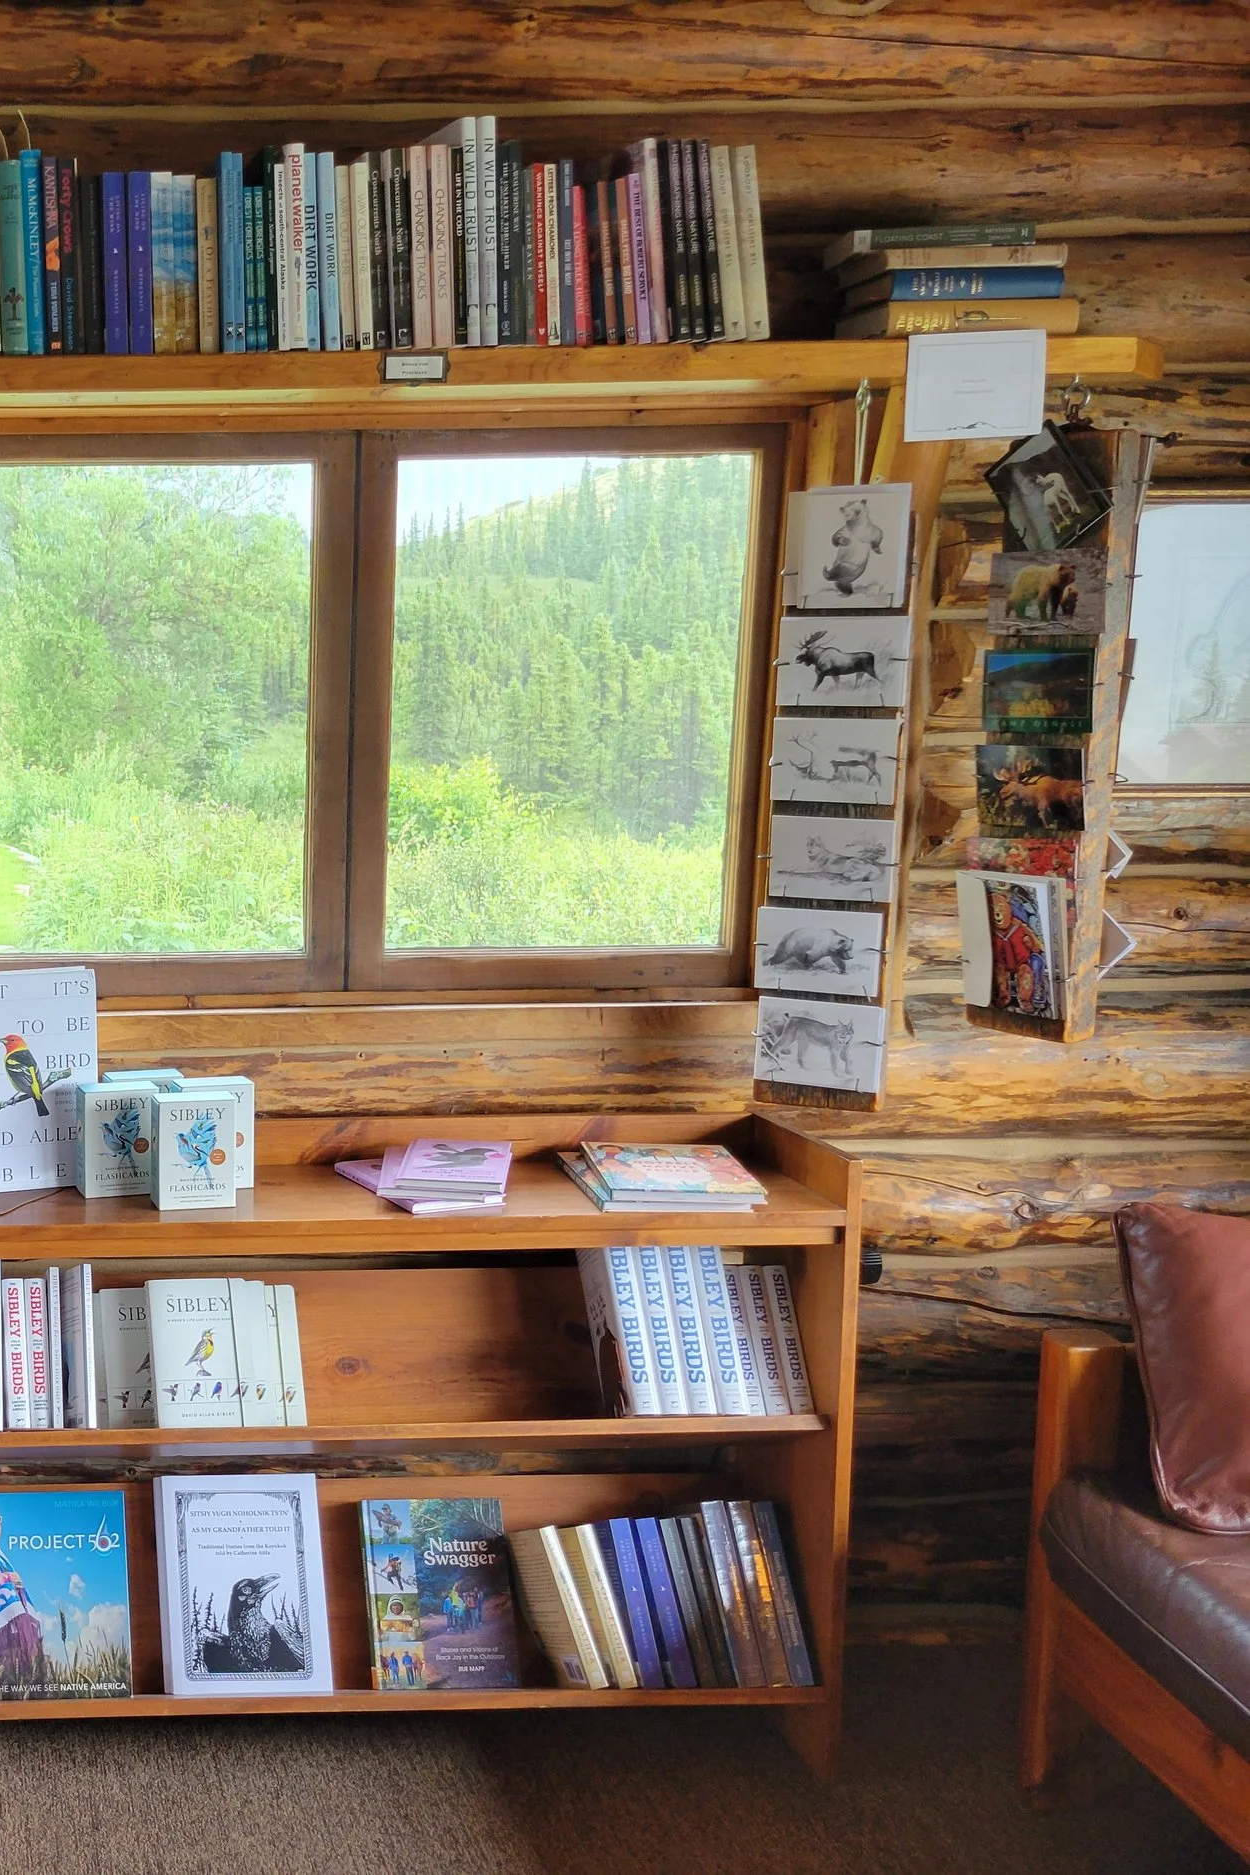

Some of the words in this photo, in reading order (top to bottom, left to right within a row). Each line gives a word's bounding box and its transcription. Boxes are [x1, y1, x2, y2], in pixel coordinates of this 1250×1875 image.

[464, 138, 475, 153] IN
[484, 137, 494, 152] IN
[44, 166, 59, 229] KANTISHNA
[60, 168, 72, 207] Forty
[393, 167, 404, 227] Crosscurrents
[464, 160, 476, 200] WILD
[484, 160, 495, 199] WILD
[536, 172, 544, 220] WARNINGS
[672, 143, 682, 220] PHOTOGRAPHING
[685, 144, 696, 220] PHOTOGRAPHING
[701, 143, 713, 218] PHOTOGRAPHING
[244, 192, 252, 219] FOREST
[254, 191, 262, 218] FOREST
[371, 170, 380, 229] Crosscurrents
[435, 188, 447, 250] CHANGING
[62, 211, 73, 254] Crows
[255, 221, 264, 259] FORENSICS
[278, 210, 286, 260] south-central
[305, 205, 316, 240] DIRT
[325, 213, 335, 239] DIRT
[395, 228, 406, 253] North
[414, 190, 426, 252] CHANGING
[465, 207, 477, 254] TRUST
[485, 206, 496, 253] TRUST
[548, 218, 556, 259] CHAMONIX
[674, 221, 684, 254] NATURE
[689, 221, 698, 255] NATURE
[705, 218, 716, 252] NATURE
[875, 231, 913, 243] FLOATING
[916, 232, 943, 242] COAST
[245, 222, 254, 260] FORENSICS
[326, 243, 336, 278] WORK
[374, 231, 383, 256] North
[306, 245, 318, 292] WORK
[416, 255, 427, 300] TRACKS
[437, 253, 448, 299] TRACKS
[537, 261, 545, 293] MYSELF
[638, 271, 647, 302] SERVICE
[206, 278, 214, 328] FEATHER
[53, 981, 90, 997] IT'S
[17, 1019, 45, 1035] TO
[66, 1016, 91, 1032] BE
[45, 1053, 91, 1070] BIRD
[95, 1096, 149, 1112] SIBLEY
[169, 1107, 227, 1122] SIBLEY
[30, 1126, 78, 1144] ALLE
[95, 1170, 150, 1181] FLASHCARDS
[169, 1183, 227, 1193] FLASHCARDS
[7, 1287, 21, 1338] SIBLEY
[29, 1287, 43, 1337] SIBLEY
[166, 1297, 231, 1313] SIBLEY
[725, 1274, 744, 1324] SIBLEY
[737, 1337, 755, 1381] BIRDS
[749, 1273, 768, 1324] SIBLEY
[761, 1337, 779, 1381] BIRDS
[772, 1273, 792, 1324] SIBLEY
[785, 1337, 804, 1381] BIRDS
[622, 1316, 649, 1384] BIRDS
[651, 1316, 677, 1384] BIRDS
[679, 1316, 706, 1384] BIRDS
[710, 1316, 739, 1384] BIRDS
[11, 1351, 24, 1395] BIRDS
[32, 1351, 46, 1394] BIRDS
[87, 1499, 118, 1508] WILBUR
[8, 1534, 85, 1550] PROJECT
[88, 1514, 120, 1553] 562
[429, 1537, 488, 1552] Nature
[423, 1551, 496, 1567] Swagger
[452, 1654, 462, 1662] Joy
[29, 1684, 43, 1692] WE
[60, 1683, 89, 1691] NATIVE
[90, 1682, 127, 1691] AMERICA
